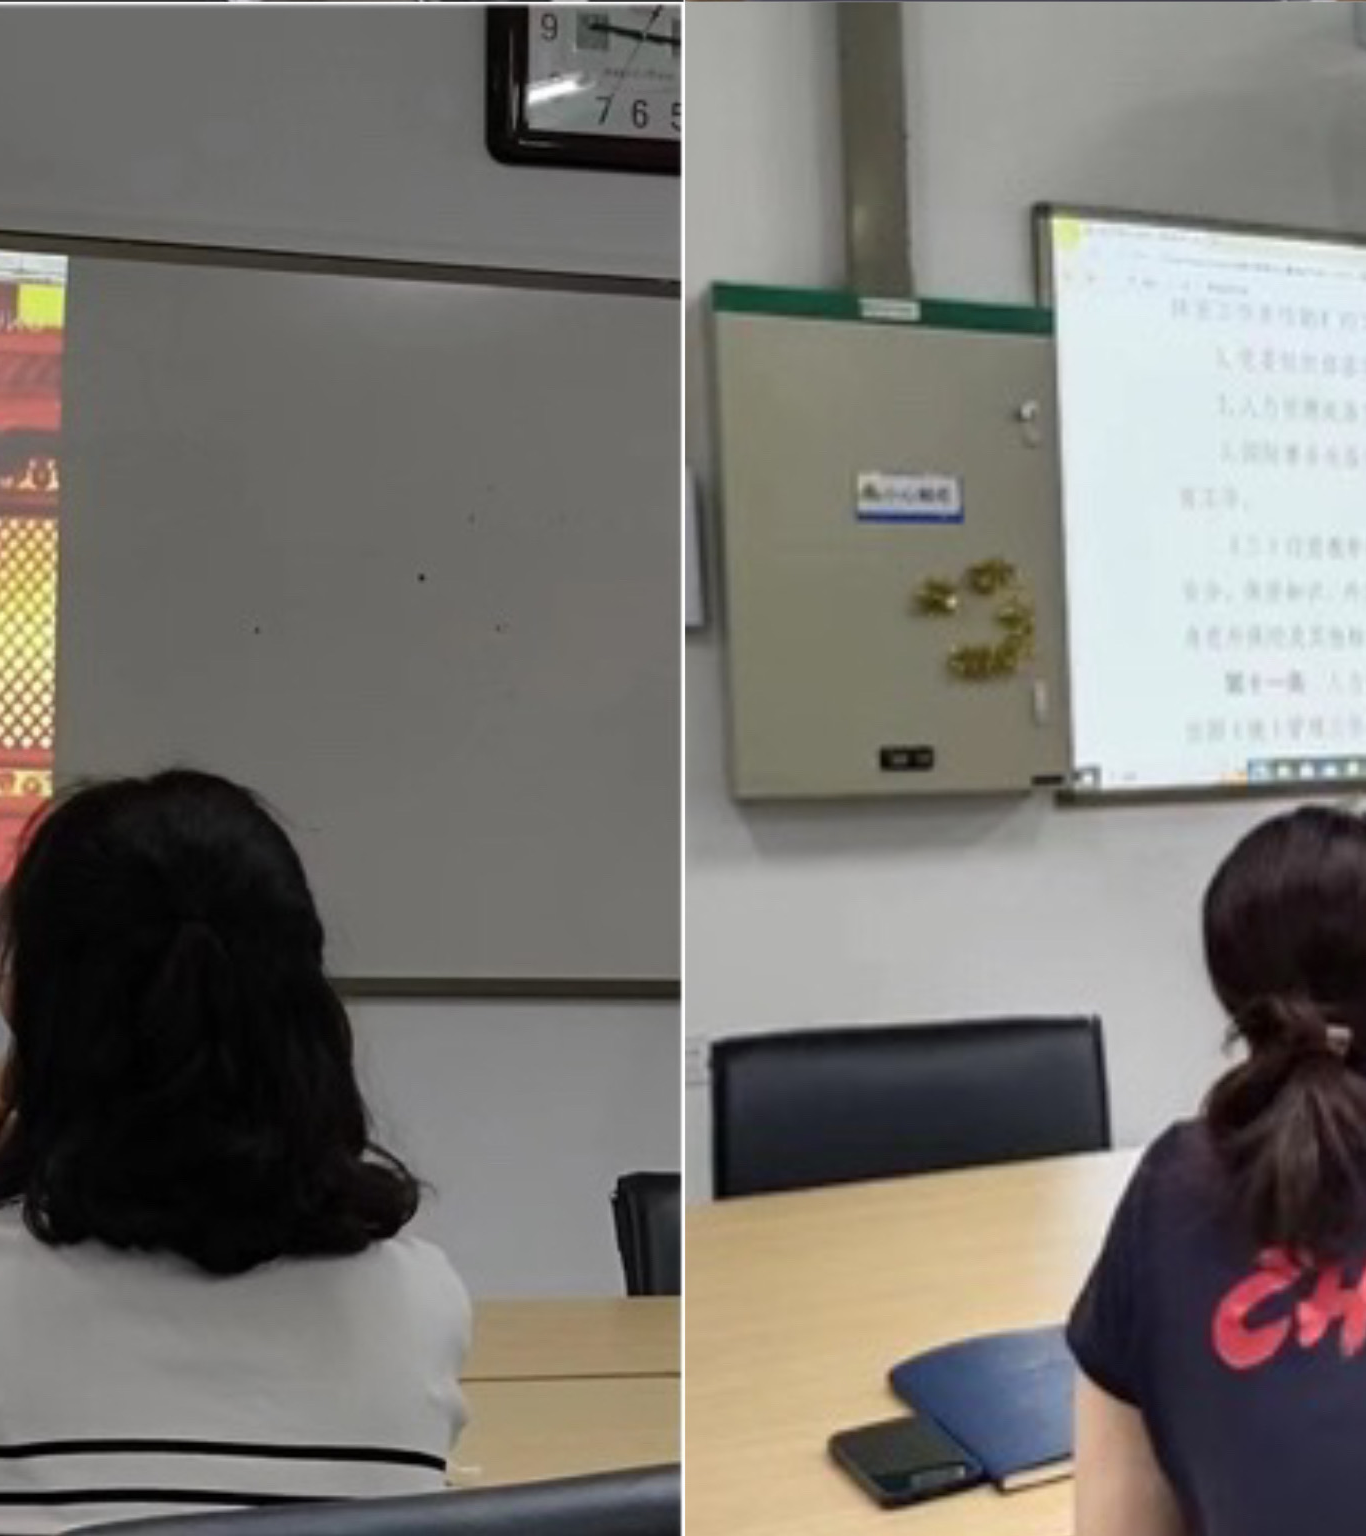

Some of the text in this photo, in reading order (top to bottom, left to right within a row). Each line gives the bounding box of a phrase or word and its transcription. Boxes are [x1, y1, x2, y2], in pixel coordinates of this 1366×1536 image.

[541, 13, 558, 42] 9
[596, 95, 612, 125] 7
[633, 99, 648, 128] 6
